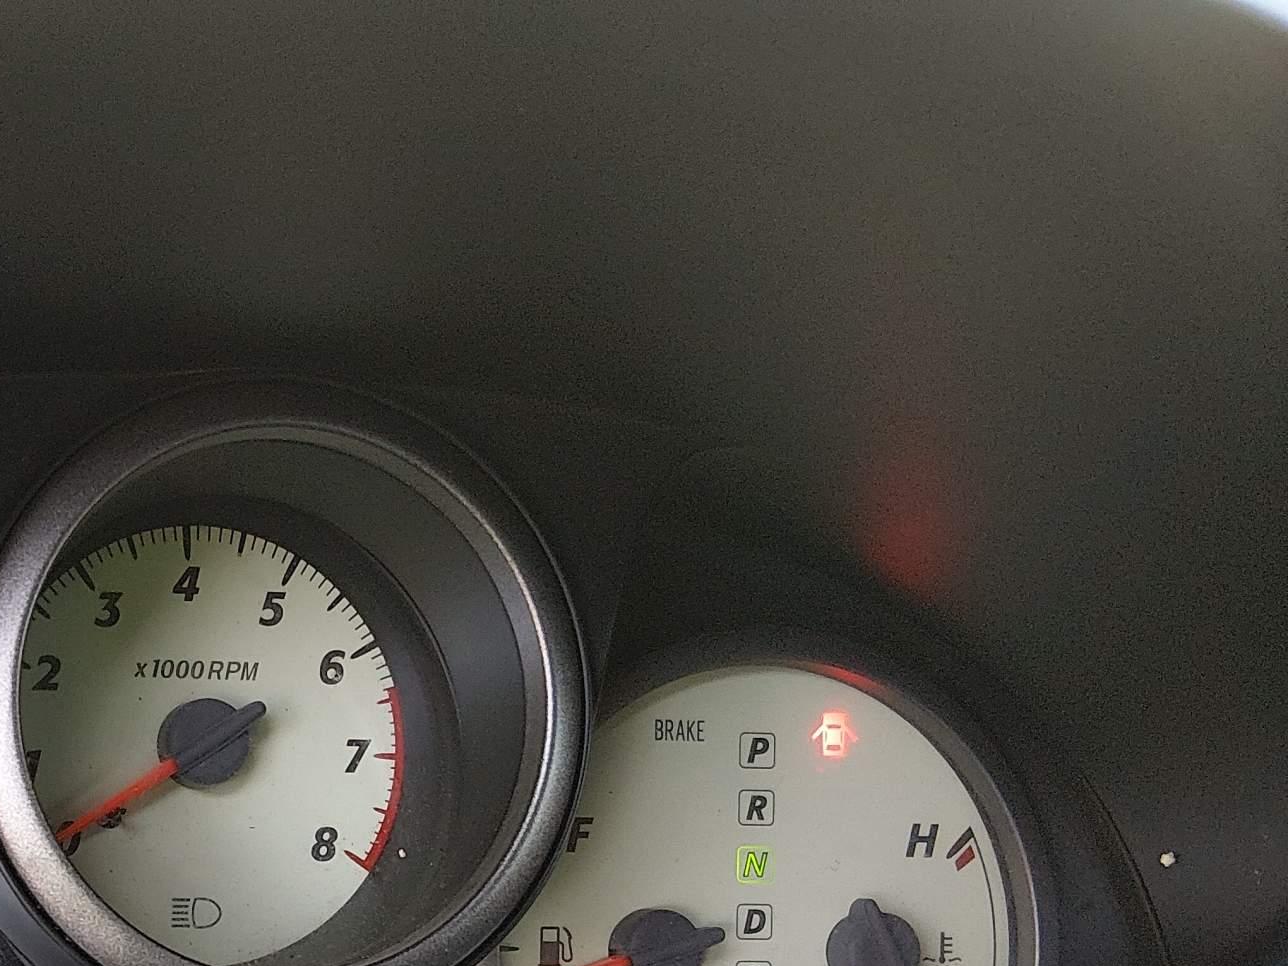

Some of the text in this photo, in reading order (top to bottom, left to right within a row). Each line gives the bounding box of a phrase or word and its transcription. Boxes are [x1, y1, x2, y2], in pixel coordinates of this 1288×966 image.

[172, 566, 201, 602] 4
[94, 591, 124, 628] 3
[259, 591, 287, 627] 5
[31, 655, 62, 691] 2
[207, 660, 259, 681] RPM
[319, 649, 346, 685] 6
[654, 719, 706, 743] BRAKE
[344, 739, 372, 774] 7
[746, 737, 770, 765] P
[746, 794, 768, 822] R
[311, 826, 338, 862] 8
[566, 816, 594, 853] F
[906, 822, 939, 859] H
[742, 851, 769, 878] N
[743, 909, 767, 935] D
